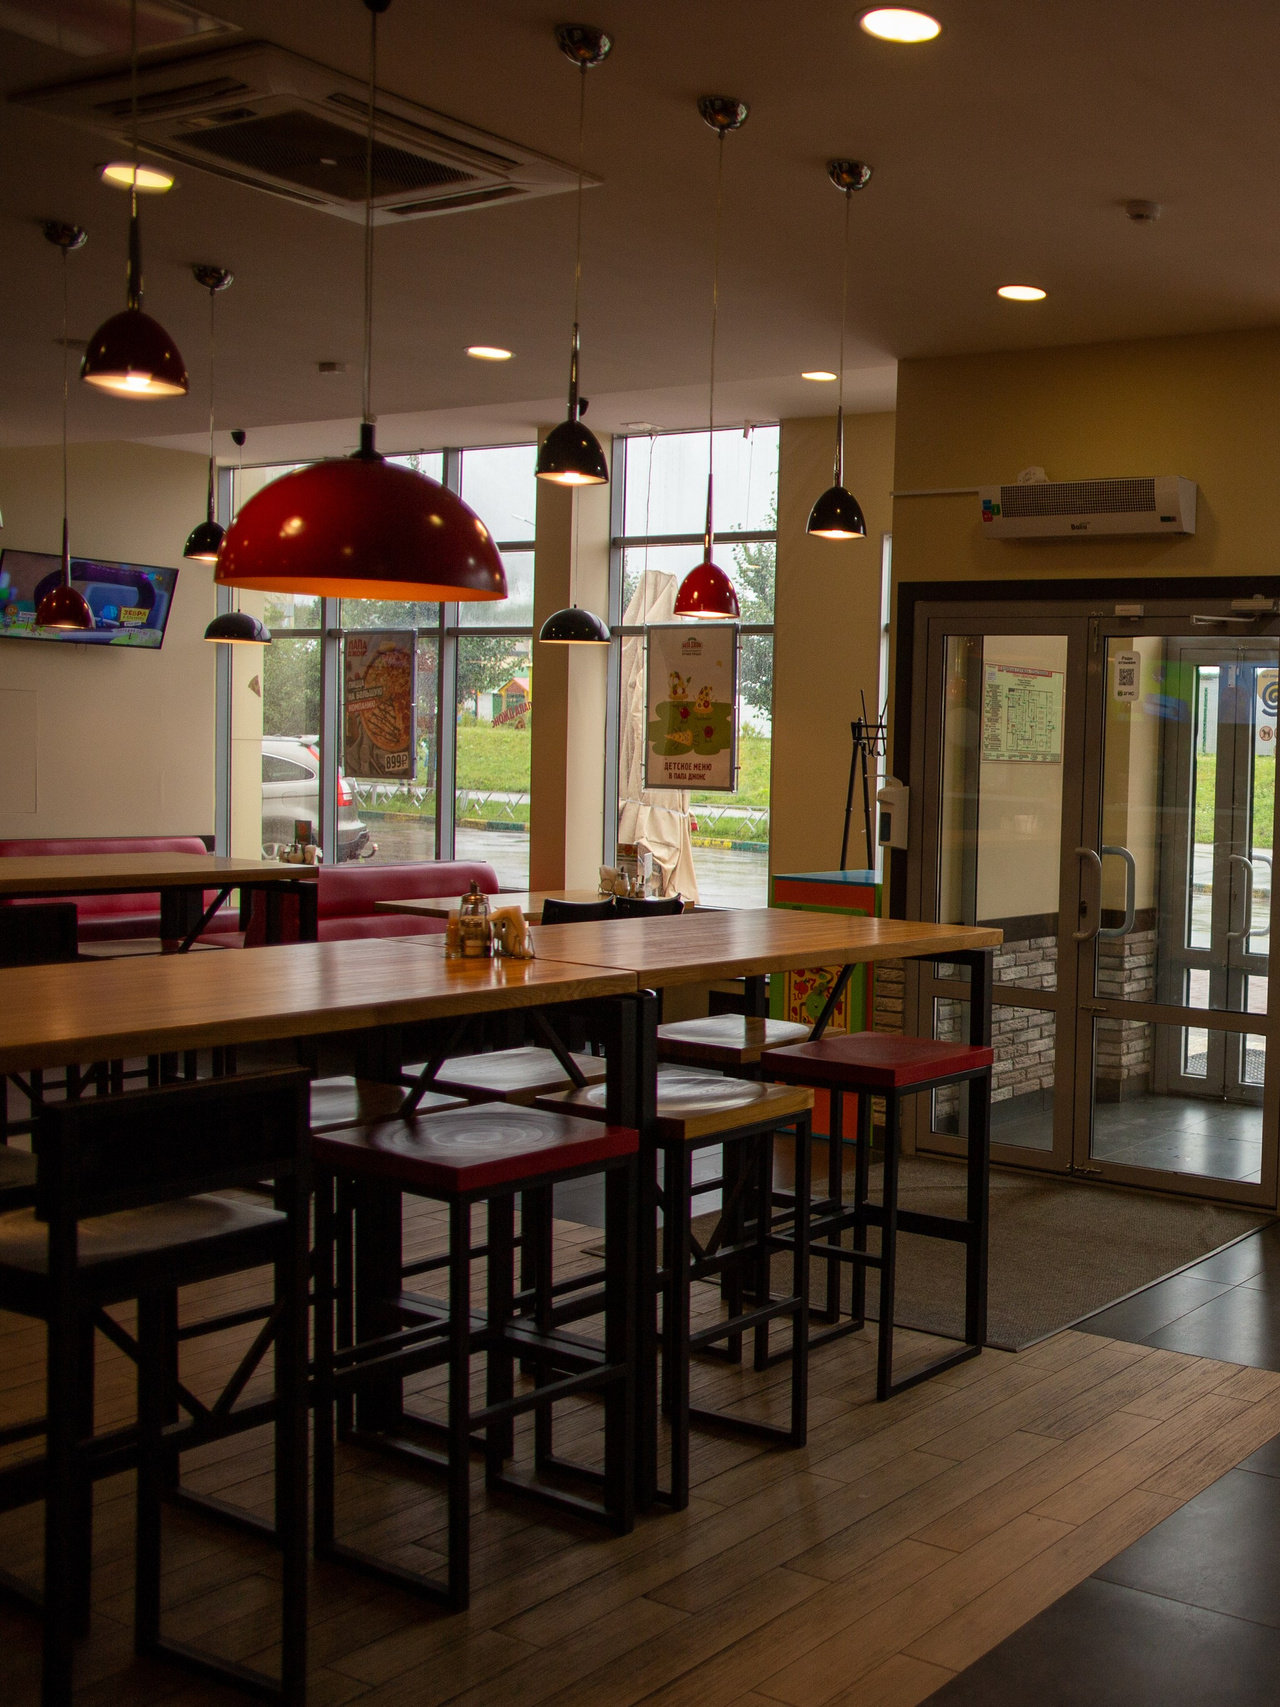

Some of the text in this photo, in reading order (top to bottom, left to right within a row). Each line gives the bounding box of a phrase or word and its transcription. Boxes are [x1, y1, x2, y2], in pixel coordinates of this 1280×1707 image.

[348, 639, 367, 650] ПАПА
[664, 762, 712, 771] ДЕТСКОЕ МЕНЮ
[688, 773, 706, 781] ДЖОНС
